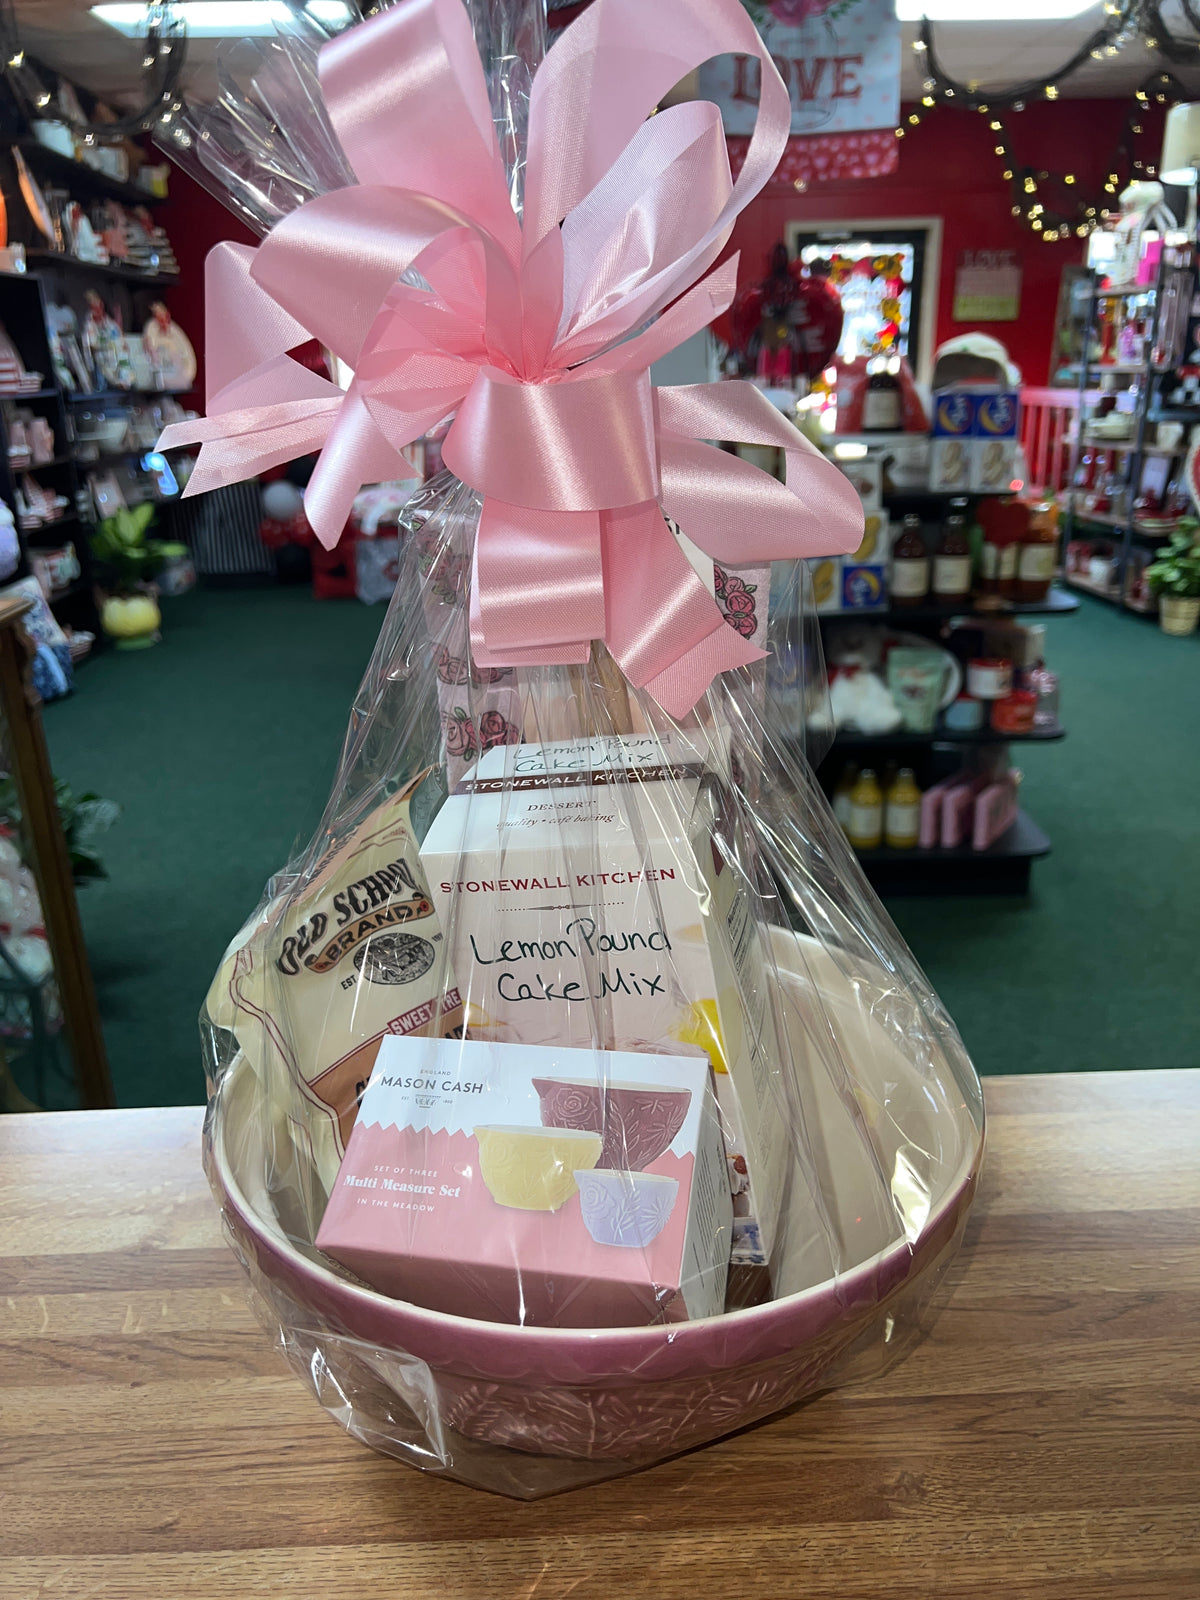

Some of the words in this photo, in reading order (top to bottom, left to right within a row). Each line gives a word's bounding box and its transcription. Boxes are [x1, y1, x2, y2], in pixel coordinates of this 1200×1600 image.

[730, 53, 865, 108] LOVE
[513, 745, 594, 760] Lemon
[595, 734, 671, 750] Pound
[515, 758, 586, 773] Cake
[591, 752, 654, 768] Mix
[465, 774, 587, 791] STONEWALL
[594, 767, 687, 782] KITCHEN
[496, 818, 538, 831] quality
[440, 874, 570, 894] STONEWALL
[576, 868, 676, 887] KITCHEN
[277, 911, 329, 976] OLD
[326, 904, 414, 961] BRAND
[470, 934, 576, 966] Lemon
[566, 918, 672, 960] Pound
[341, 974, 357, 990] EST
[497, 973, 592, 1002] Cake
[592, 968, 666, 1000] Mix
[391, 1003, 433, 1036] SWEET
[381, 1076, 436, 1090] MASON
[441, 1080, 484, 1094] CASH
[374, 1165, 390, 1173] SET
[409, 1168, 438, 1178] THREE
[343, 1174, 378, 1189] Multi
[380, 1178, 436, 1195] Measure
[439, 1184, 461, 1198] Set
[371, 1199, 389, 1208] THE
[392, 1202, 436, 1213] MEADOW
